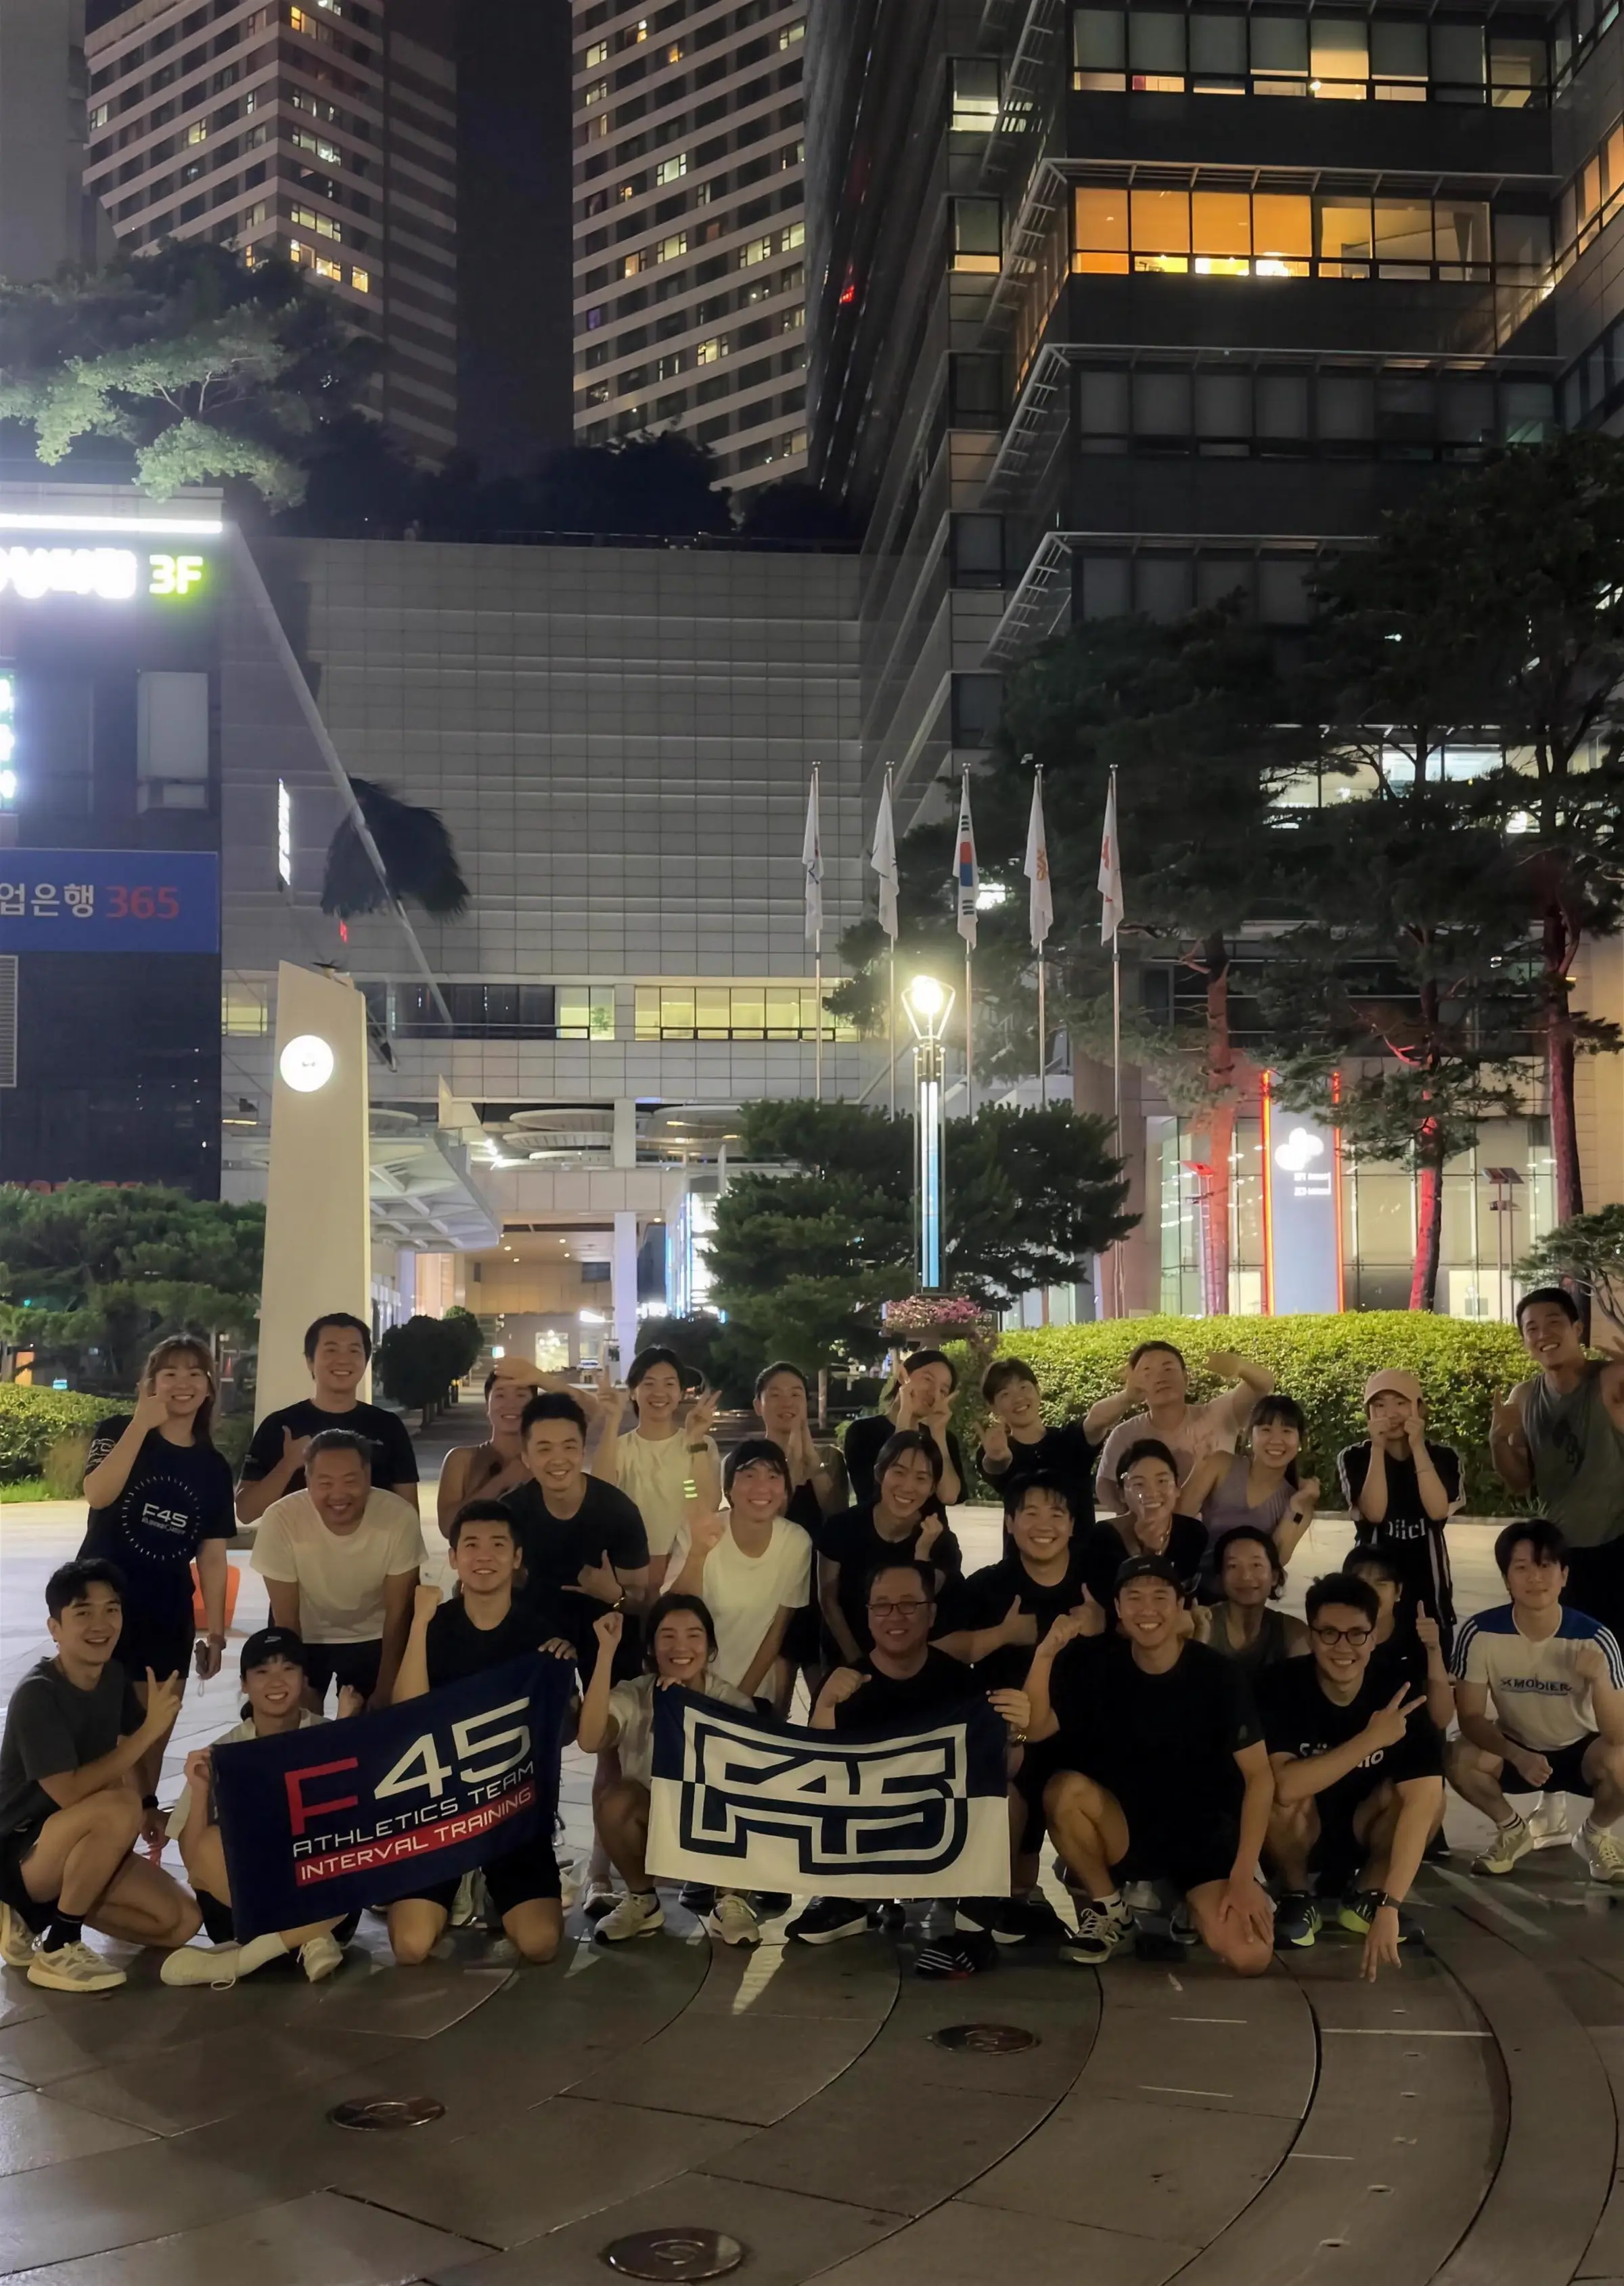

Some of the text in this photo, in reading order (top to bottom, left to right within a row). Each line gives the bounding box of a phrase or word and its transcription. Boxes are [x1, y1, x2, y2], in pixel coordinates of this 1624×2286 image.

[149, 555, 203, 594] 3F
[105, 885, 180, 919] 365
[142, 1502, 188, 1528] F45
[284, 1697, 531, 1836] F45
[293, 1760, 534, 1858] ATHLETICS TEAM
[301, 1787, 533, 1881] INTERVAL TRAINING
